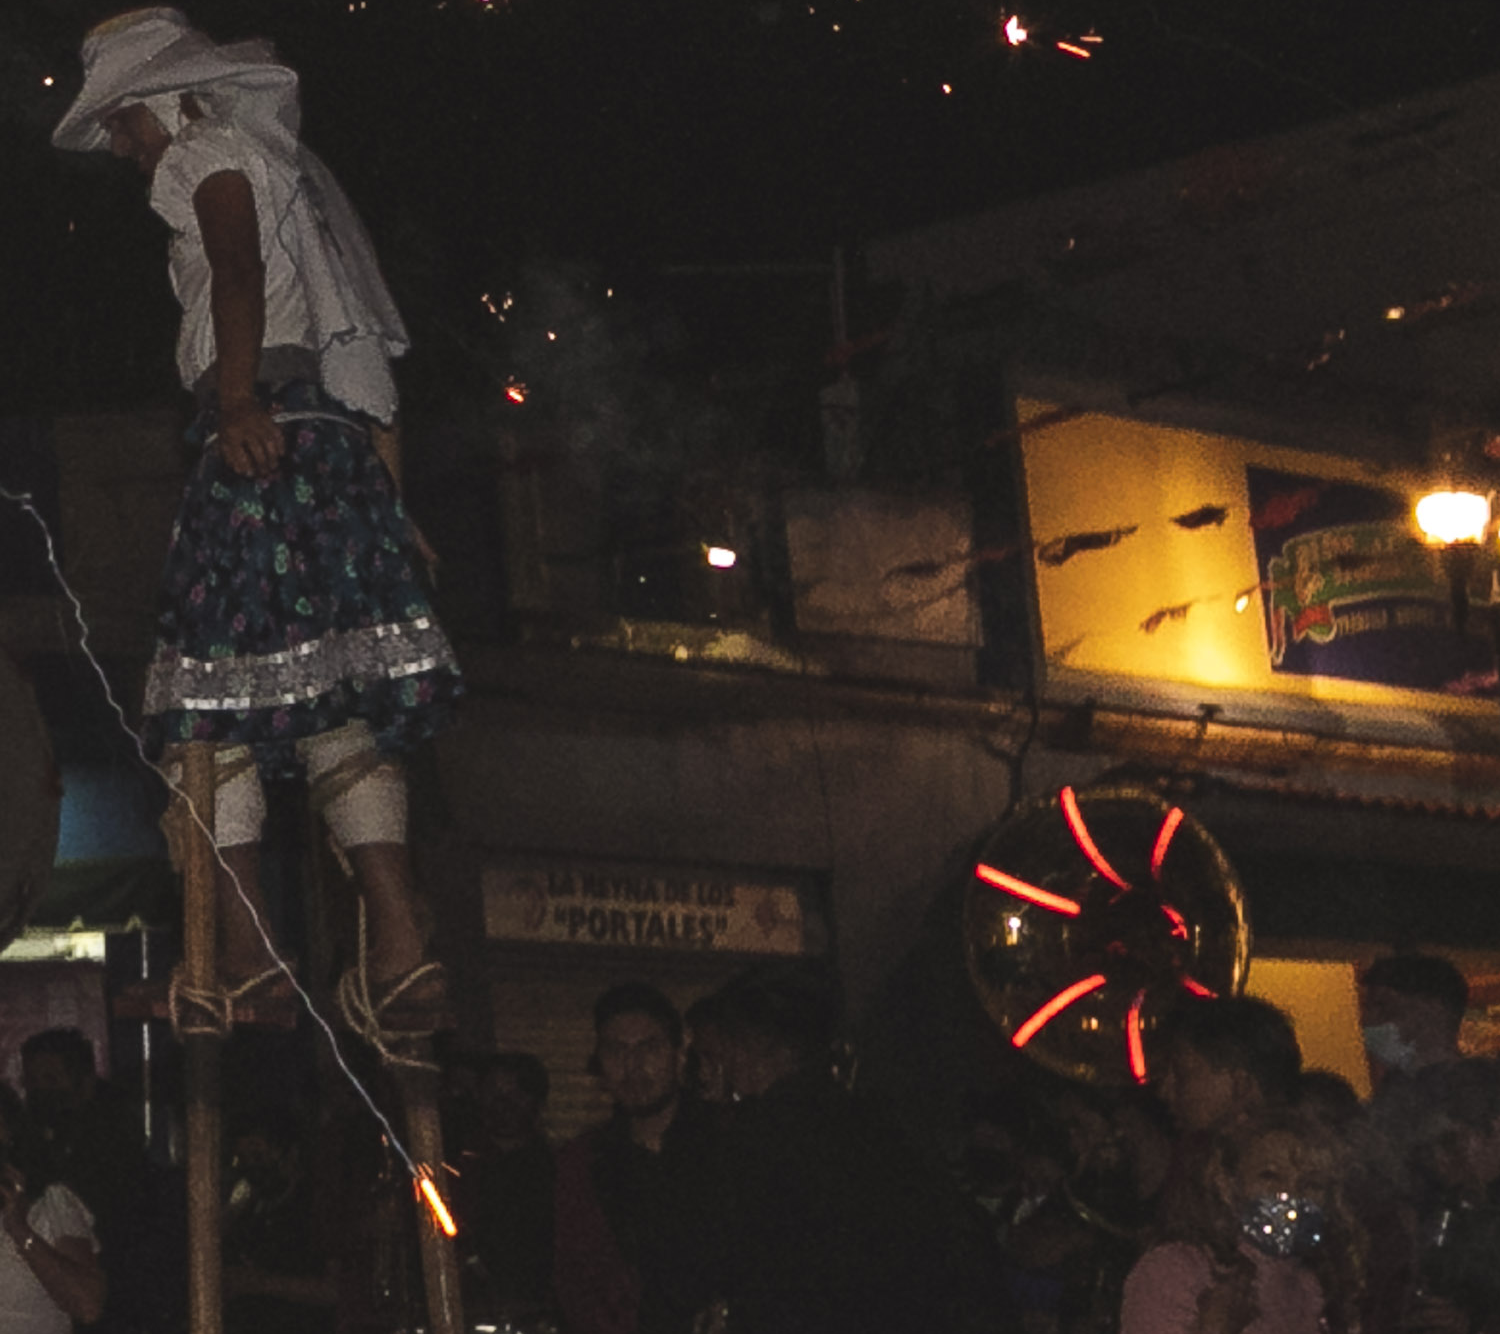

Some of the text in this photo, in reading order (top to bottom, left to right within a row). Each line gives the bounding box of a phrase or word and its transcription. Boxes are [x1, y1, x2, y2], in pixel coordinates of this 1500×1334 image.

[548, 871, 575, 897] LA
[664, 879, 691, 904] DE
[697, 881, 735, 907] LOS
